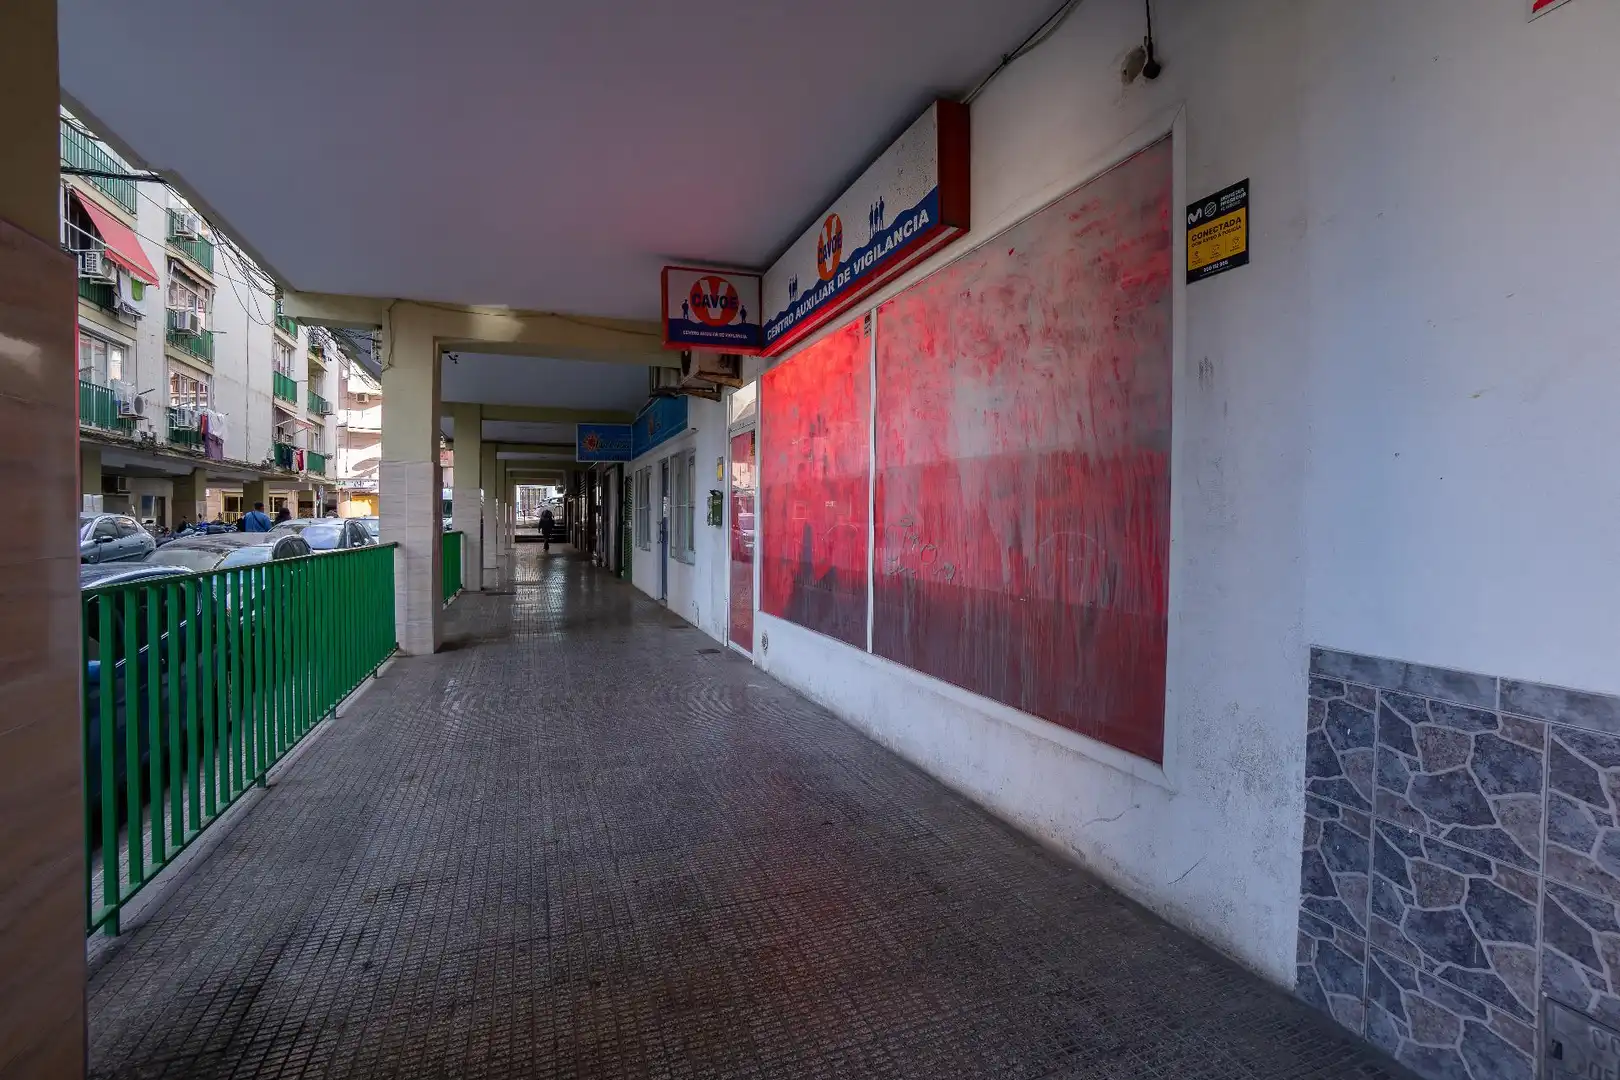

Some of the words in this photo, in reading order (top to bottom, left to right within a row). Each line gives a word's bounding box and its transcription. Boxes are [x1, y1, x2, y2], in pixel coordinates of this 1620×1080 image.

[1191, 217, 1241, 242] CONECTADA
[818, 231, 843, 264] CAVOE
[767, 312, 794, 341] CENTRO
[795, 281, 835, 318] AUXILIAR
[837, 267, 851, 289] DE
[853, 208, 930, 275] VIGILANCIA
[692, 294, 738, 309] CAVOE
